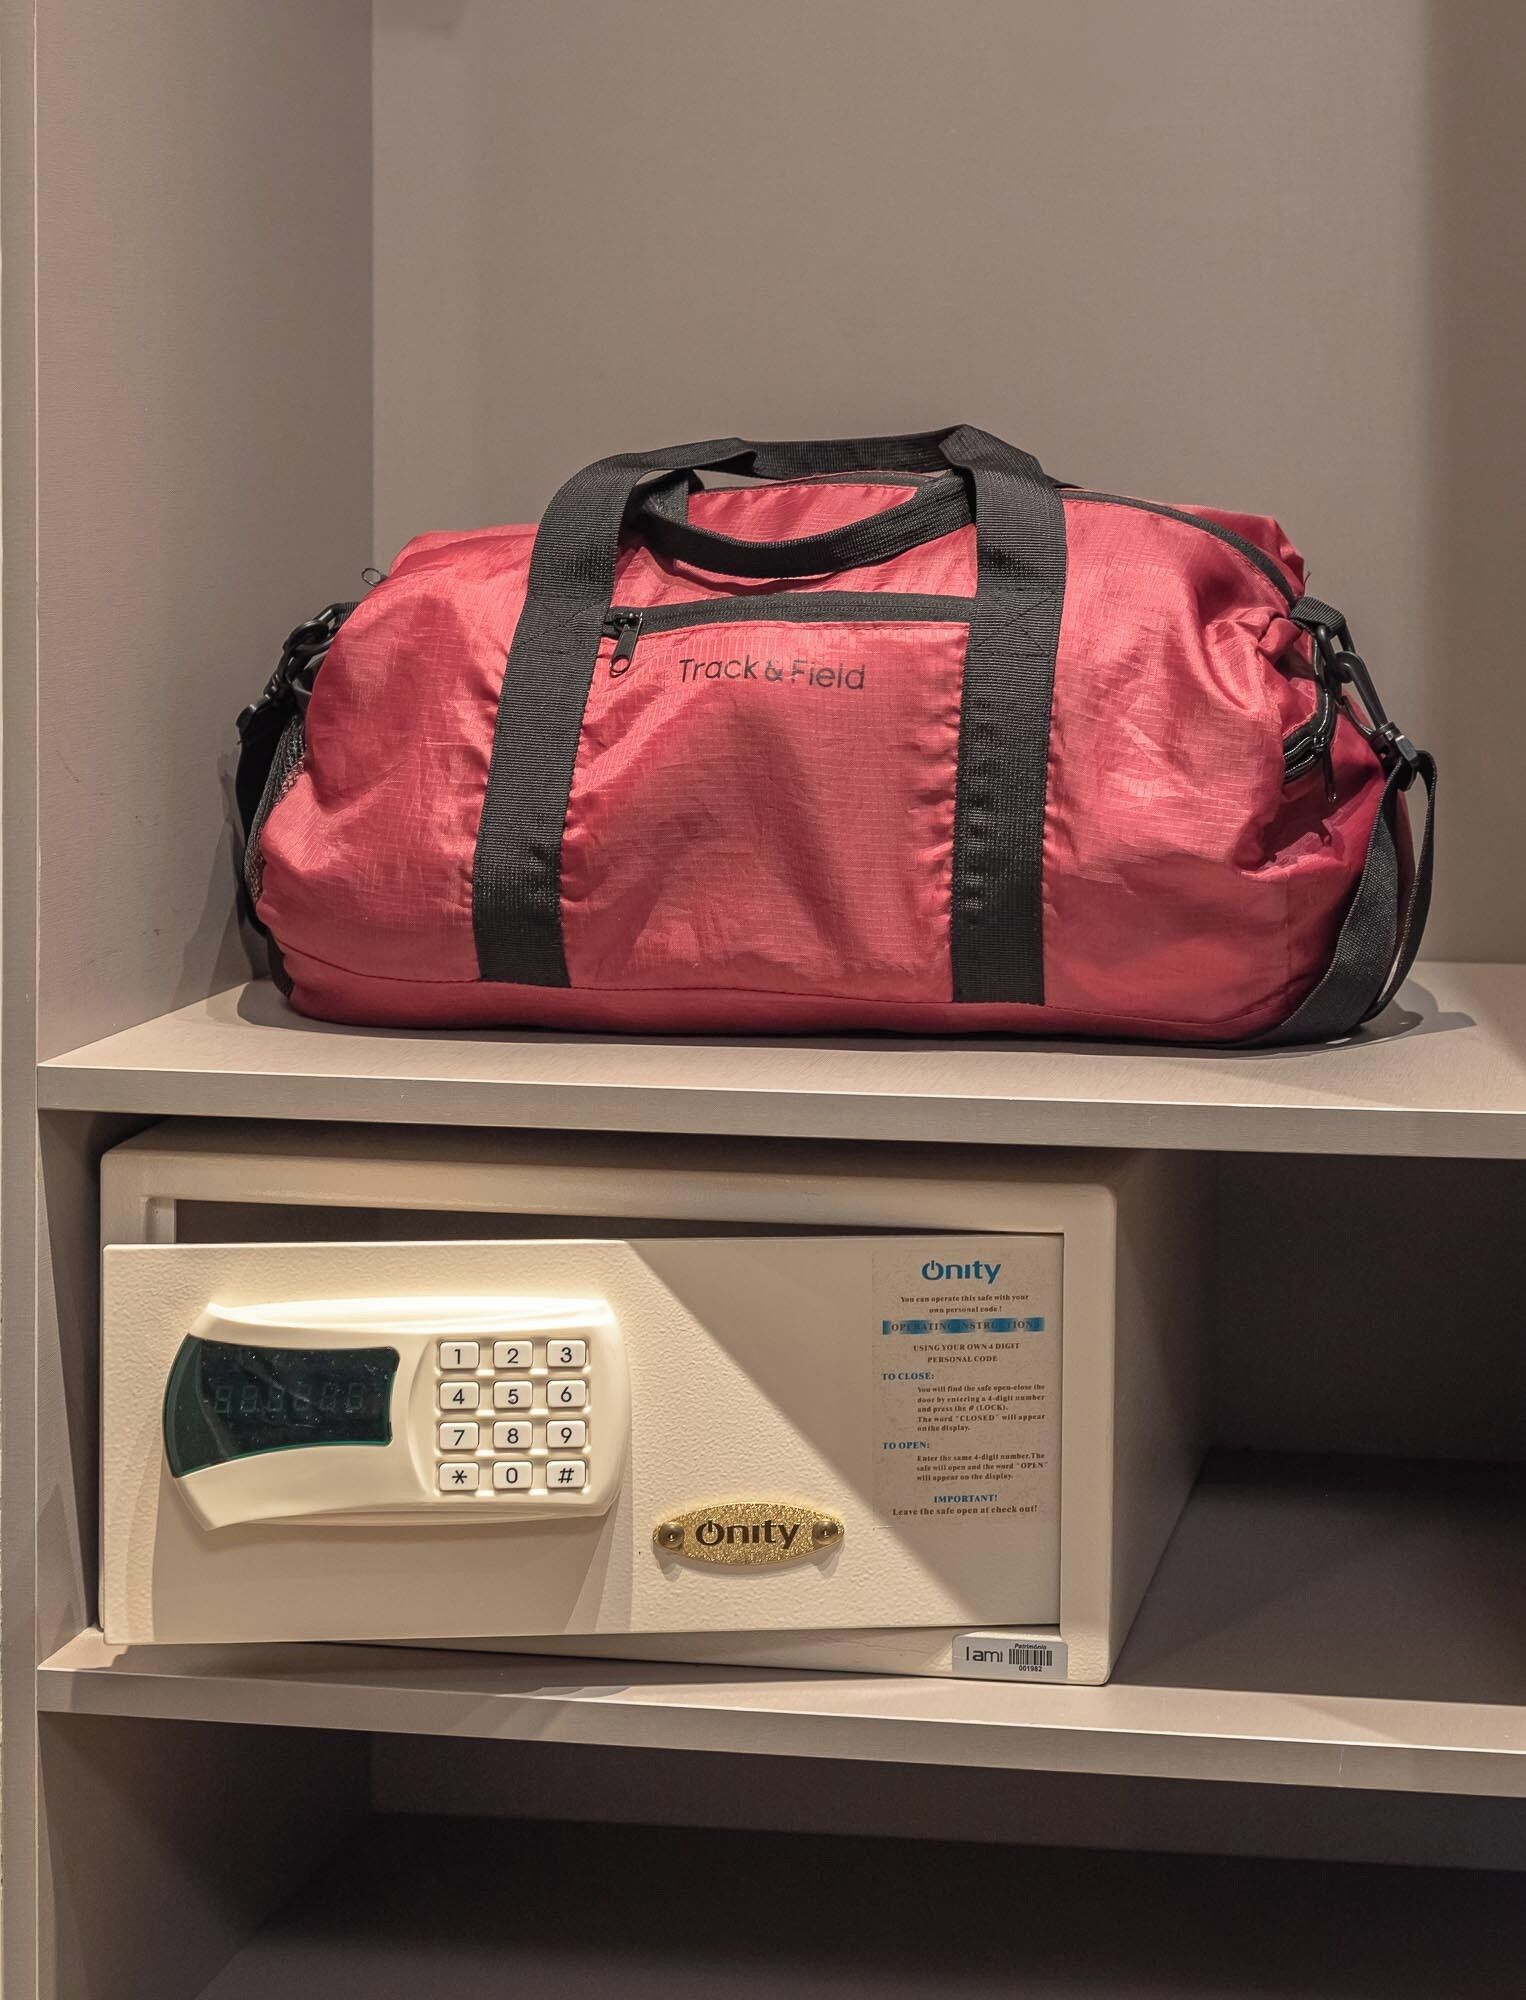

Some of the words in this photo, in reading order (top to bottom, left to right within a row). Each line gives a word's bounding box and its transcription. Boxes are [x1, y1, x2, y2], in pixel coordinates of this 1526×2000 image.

[679, 655, 759, 684] Track
[764, 656, 783, 680] &
[791, 659, 865, 690] Field
[922, 1260, 1002, 1284] Onity
[931, 1296, 960, 1304] operate
[946, 1306, 979, 1314] personal
[955, 1320, 1040, 1330] NSTRUTIONS
[454, 1348, 461, 1363] 1
[507, 1348, 519, 1363] 2
[560, 1347, 572, 1363] 3
[882, 1373, 896, 1381] TO
[898, 1372, 935, 1380] CLOSE:
[993, 1384, 1032, 1392] open-close
[452, 1389, 466, 1404] 4
[508, 1388, 519, 1404] 5
[561, 1387, 572, 1402] 6
[988, 1395, 1014, 1403] 4-digit
[941, 1424, 970, 1432] display.
[453, 1429, 465, 1445] 7
[507, 1428, 519, 1444] 8
[561, 1427, 572, 1443] 9
[899, 1441, 930, 1449] OPEN:
[506, 1468, 518, 1484] 0
[985, 1473, 1013, 1481] display.
[934, 1495, 999, 1503] IMPORTANT!
[893, 1508, 918, 1516] Leave
[957, 1508, 979, 1516] open
[991, 1505, 1018, 1513] check
[1019, 1505, 1038, 1513] out!
[695, 1519, 801, 1549] Onity
